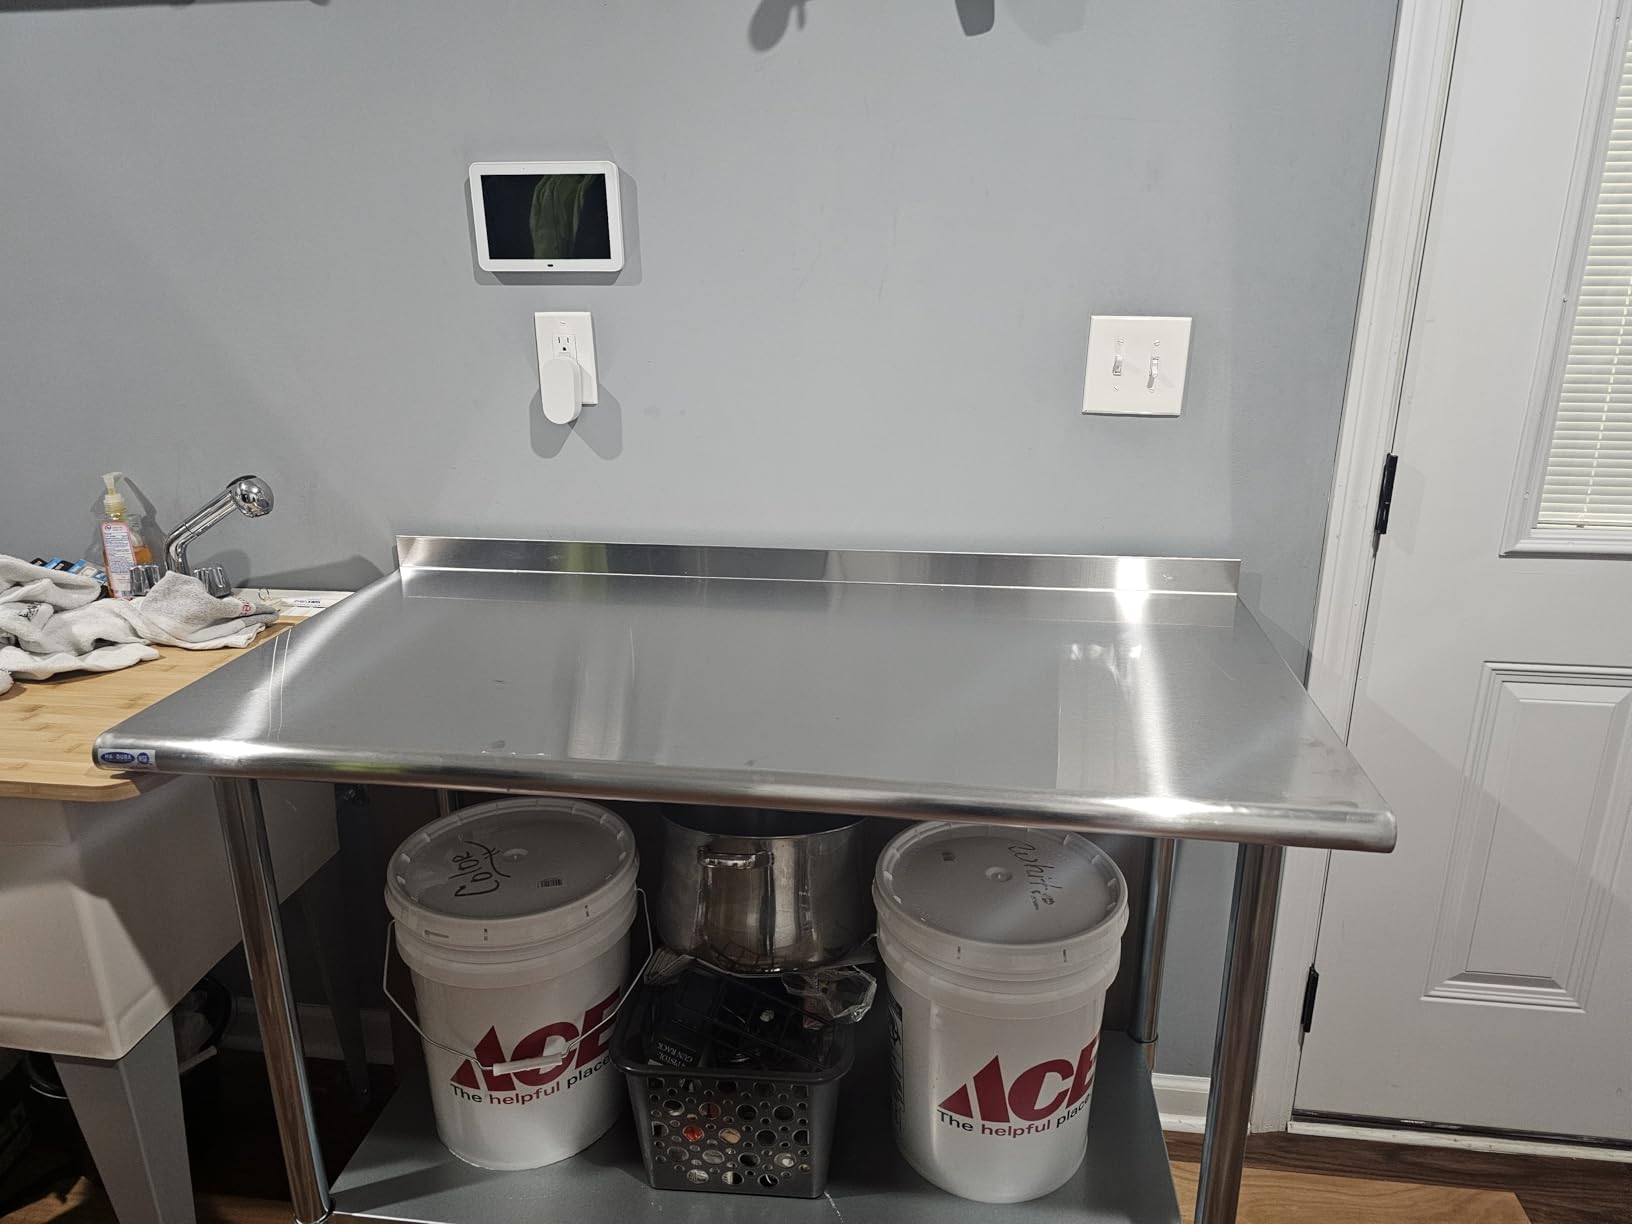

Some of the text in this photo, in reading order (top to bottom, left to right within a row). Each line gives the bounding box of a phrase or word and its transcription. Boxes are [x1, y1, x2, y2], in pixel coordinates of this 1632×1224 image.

[657, 1042, 677, 1055] RACK
[450, 1055, 610, 1105] The helpful place
[936, 1109, 974, 1131] The
[981, 1119, 1051, 1138] helpful
